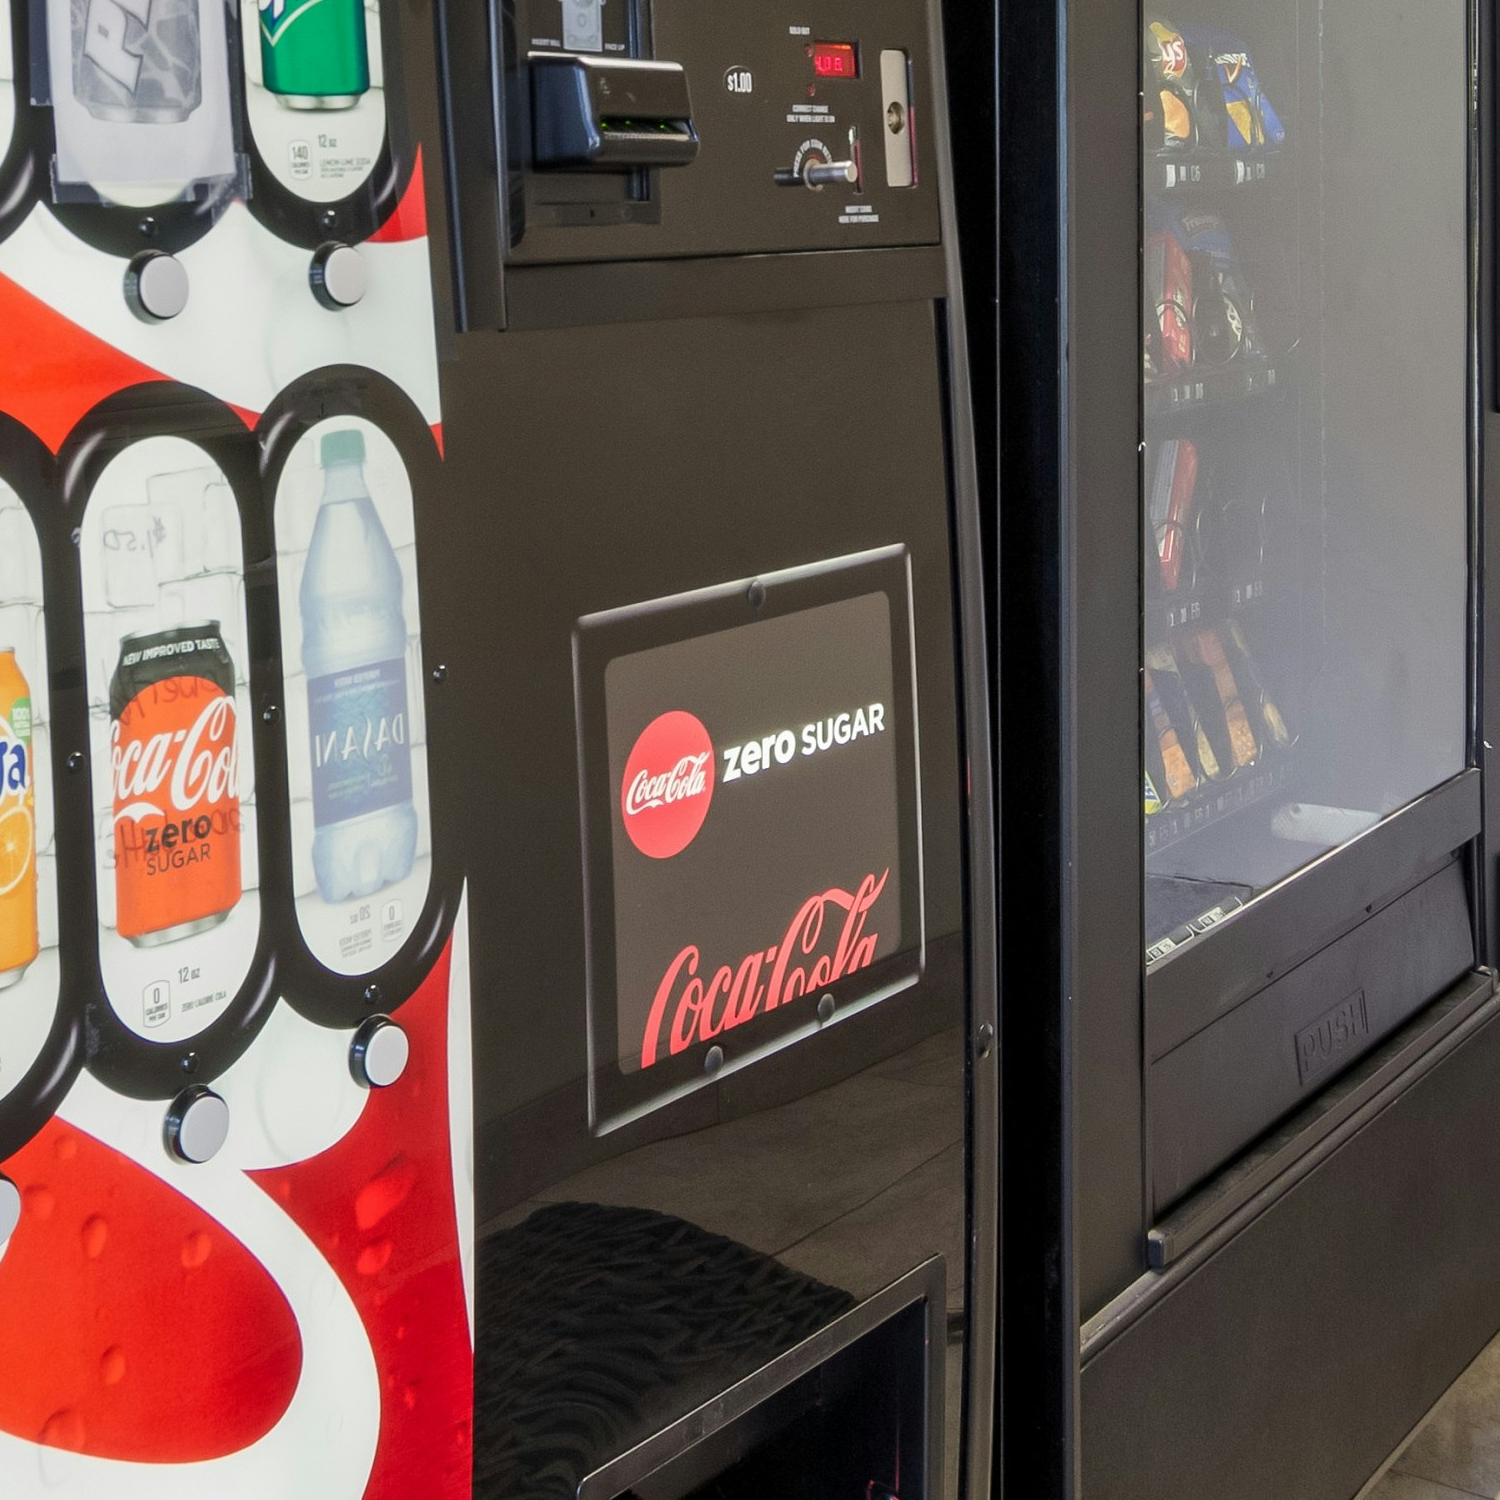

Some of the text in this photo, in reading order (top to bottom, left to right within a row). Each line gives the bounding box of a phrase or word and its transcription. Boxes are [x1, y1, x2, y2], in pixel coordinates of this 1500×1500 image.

[728, 72, 752, 93] $1.00
[292, 145, 309, 160] 140
[318, 134, 327, 148] 12
[793, 139, 823, 177] PRESS FOR COIN
[122, 637, 220, 667] NEW IMPROVED TASTE
[626, 702, 885, 815] Coca-Cola zero SUGAR
[145, 812, 212, 854] zero
[146, 843, 211, 876] SUGAR
[179, 967, 189, 983] 12
[153, 987, 160, 1004] 0
[1303, 998, 1366, 1073] PUSH
